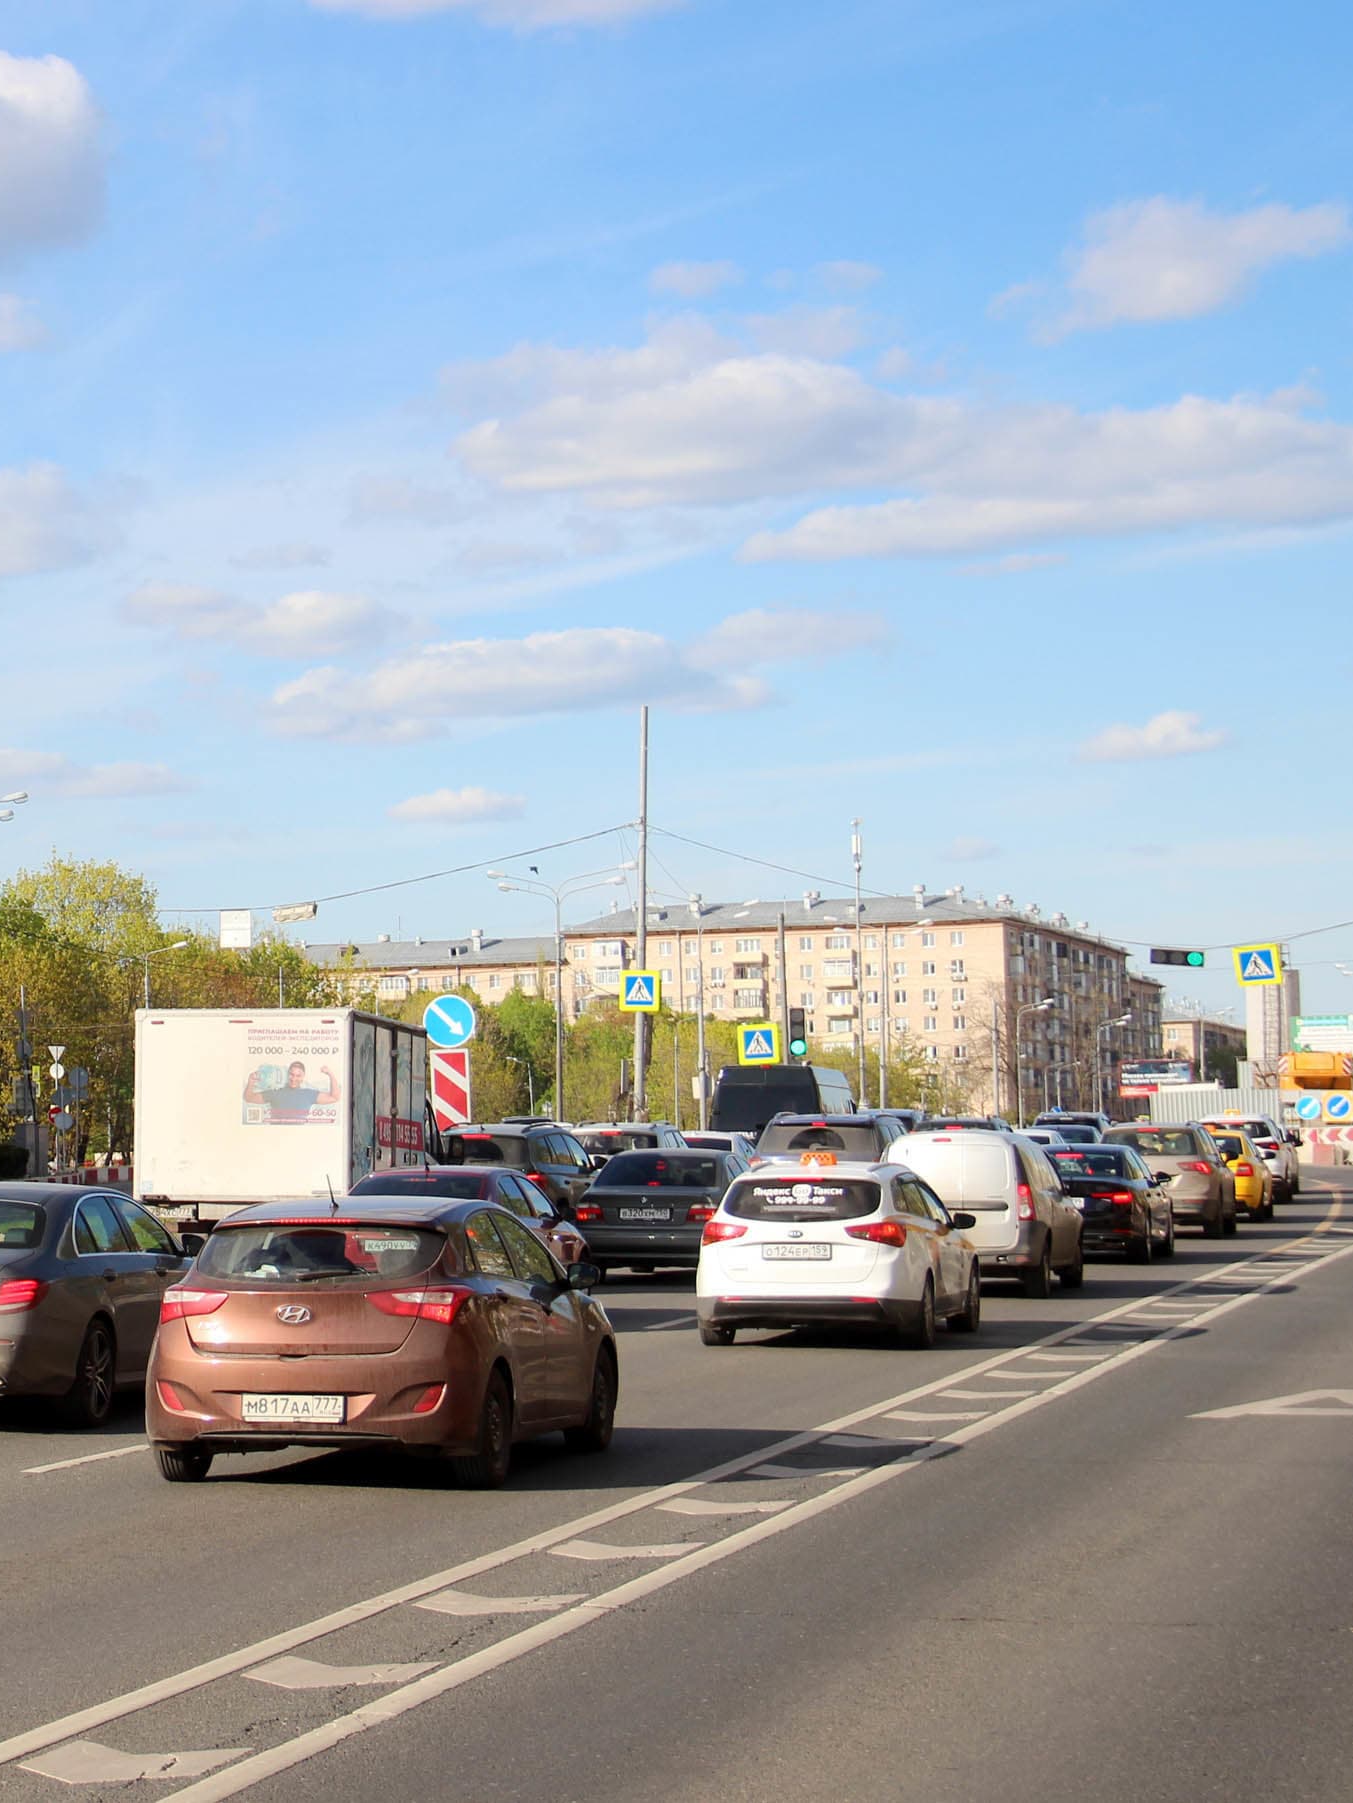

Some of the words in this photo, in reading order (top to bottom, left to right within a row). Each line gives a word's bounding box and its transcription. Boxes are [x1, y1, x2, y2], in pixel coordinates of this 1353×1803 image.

[248, 1046, 263, 1054] 120
[265, 1046, 283, 1054] 000
[292, 1046, 309, 1055] 240
[311, 1046, 329, 1055] 000
[753, 1187, 791, 1197] Яндекс
[813, 1187, 844, 1196] Такси
[247, 1397, 310, 1414] М817АА
[314, 1397, 339, 1410] 777
